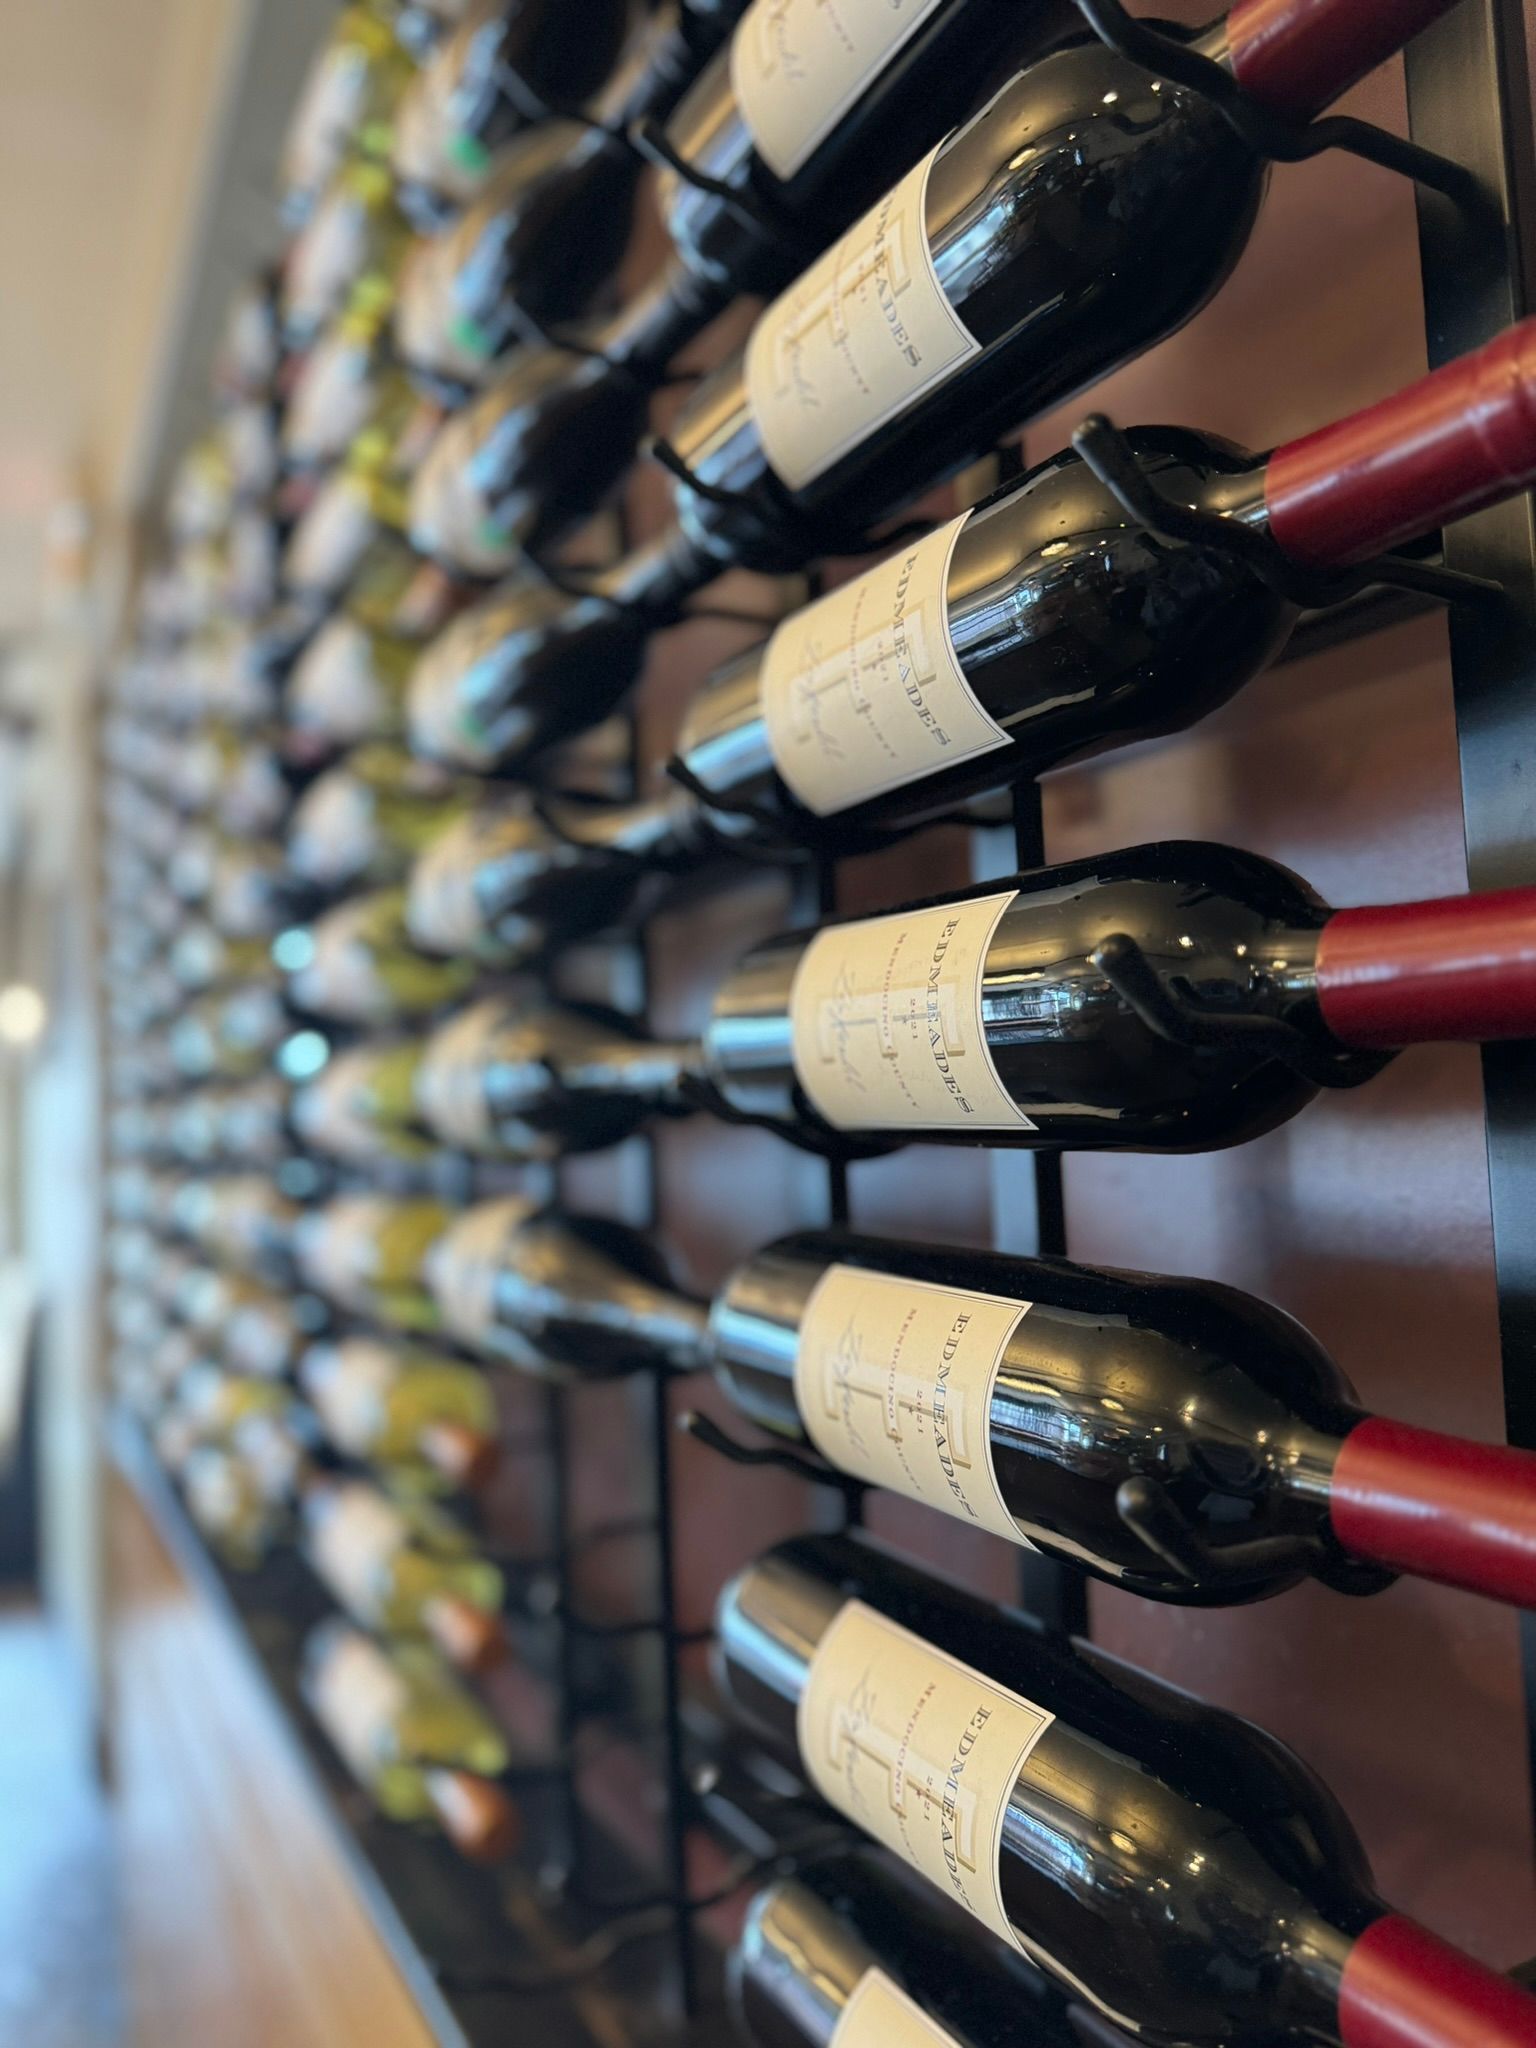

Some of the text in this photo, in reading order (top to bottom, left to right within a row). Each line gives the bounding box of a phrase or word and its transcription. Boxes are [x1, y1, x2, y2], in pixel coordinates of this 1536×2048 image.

[892, 552, 951, 746] EDMEADES
[927, 918, 974, 1113] EDMEADES
[933, 1311, 979, 1518] EDMEADES
